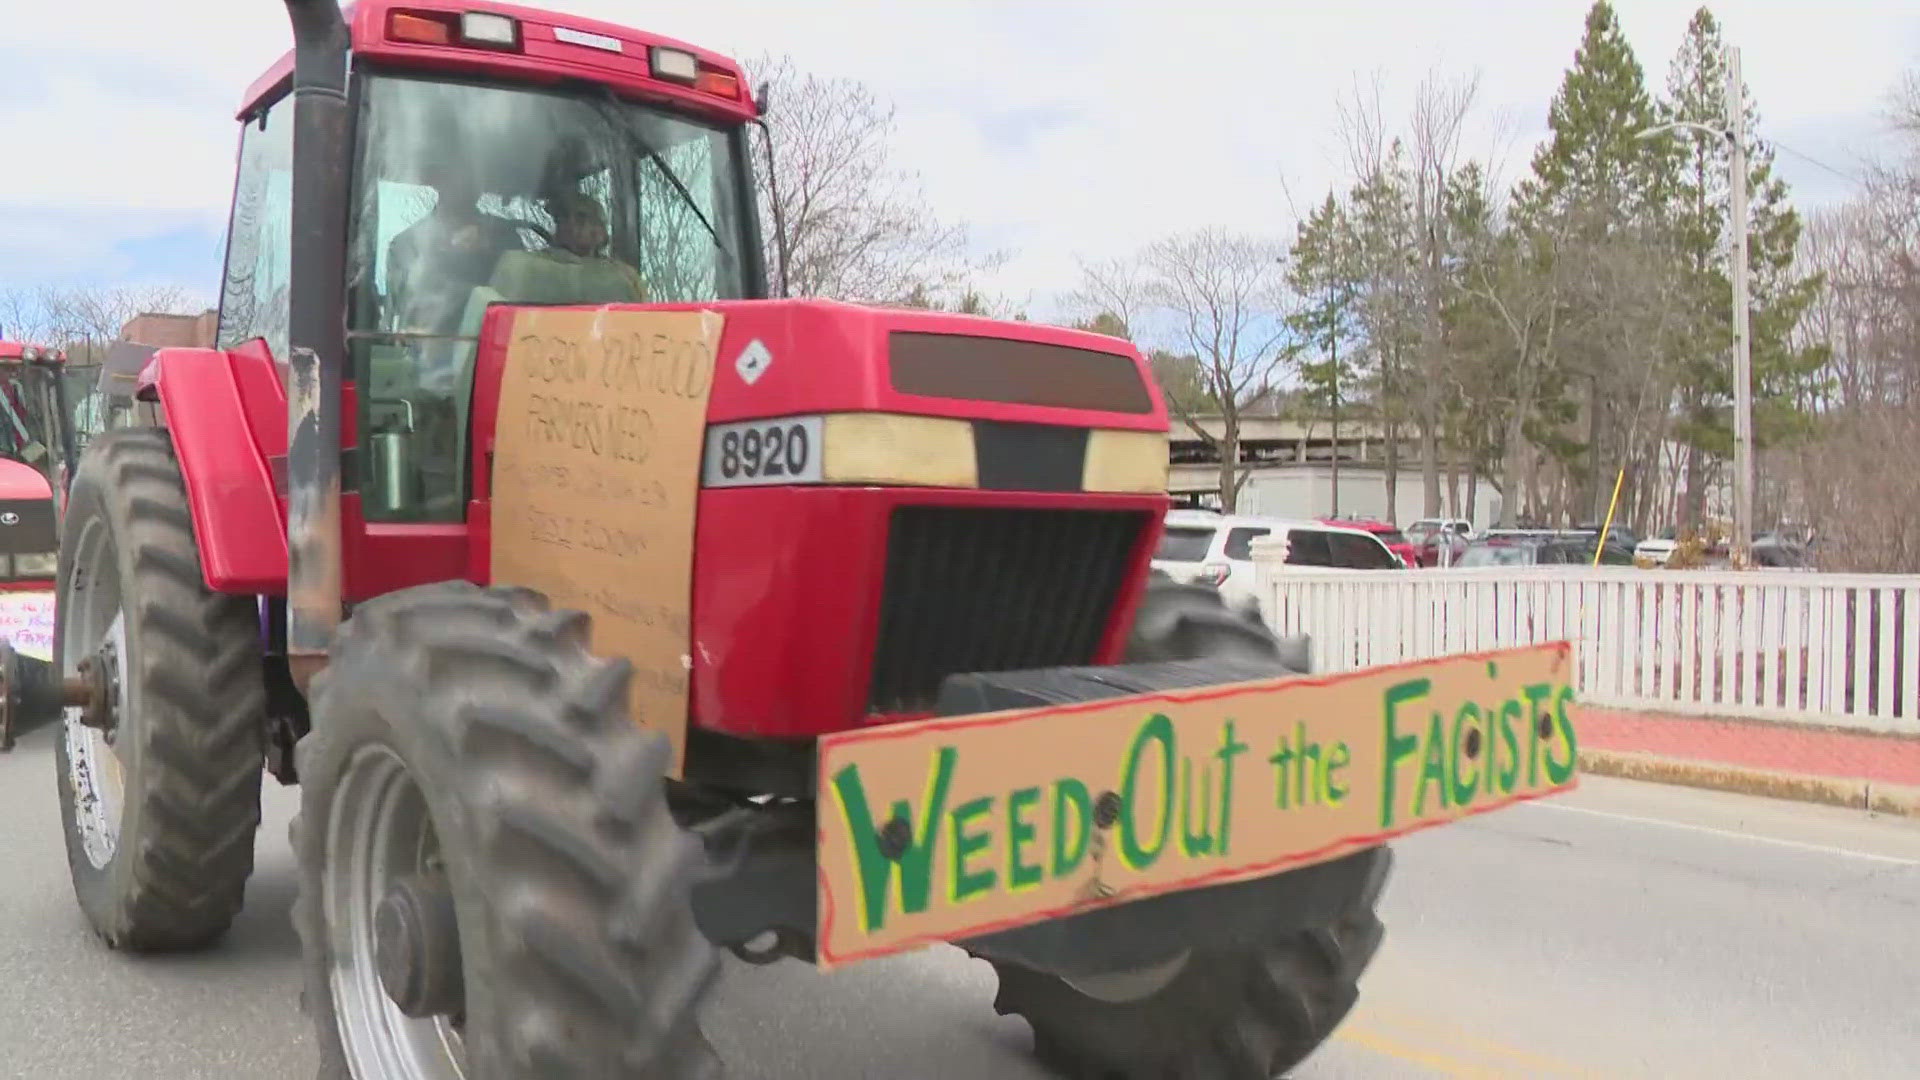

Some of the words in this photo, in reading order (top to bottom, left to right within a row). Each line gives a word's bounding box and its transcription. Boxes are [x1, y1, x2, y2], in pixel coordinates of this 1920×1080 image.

[651, 333, 712, 399] FOOD
[721, 423, 808, 478] 8920
[830, 745, 1094, 935] WEED
[1115, 712, 1250, 870] Out
[1267, 720, 1351, 810] the
